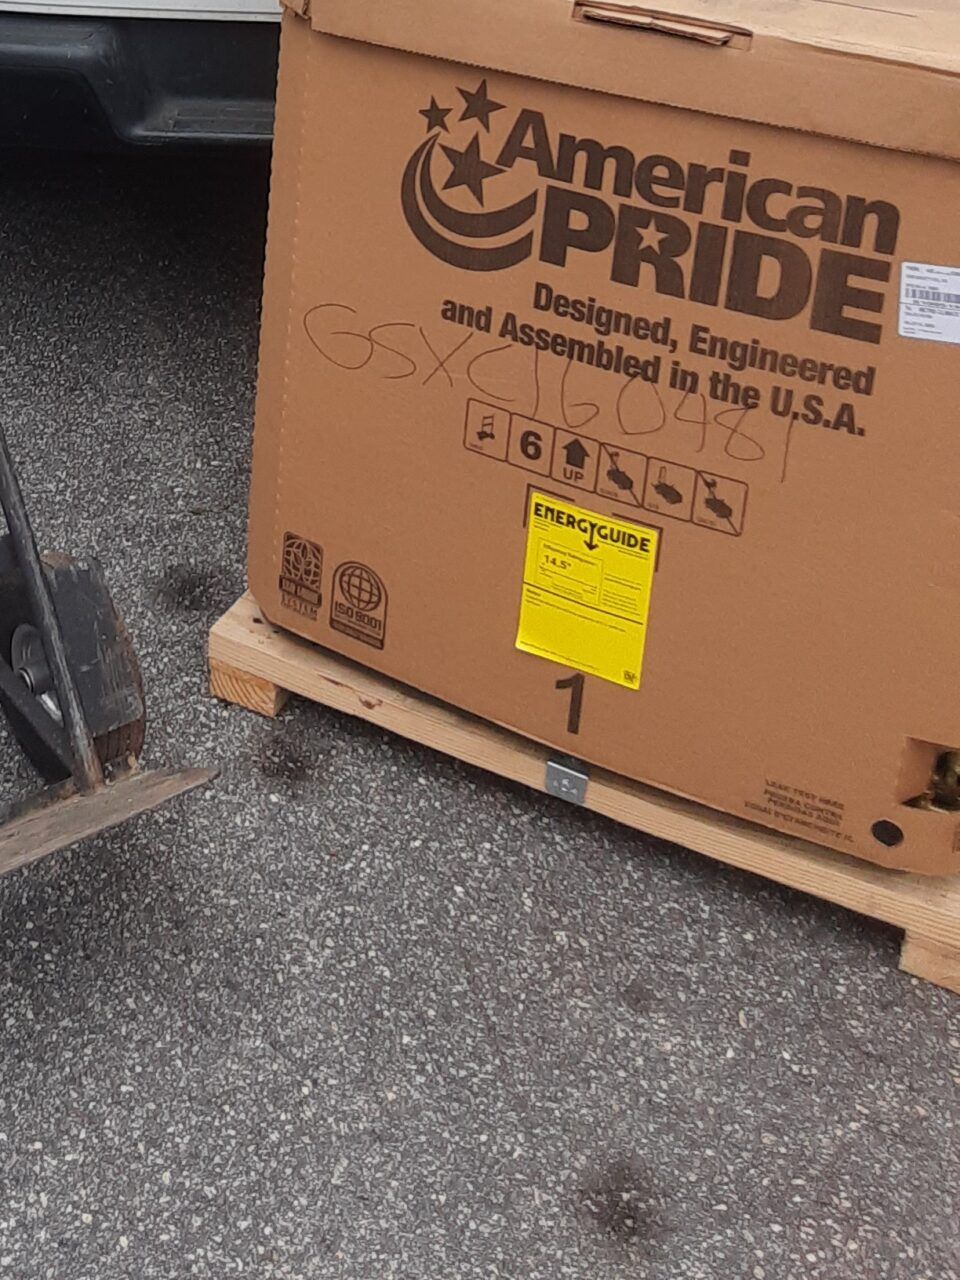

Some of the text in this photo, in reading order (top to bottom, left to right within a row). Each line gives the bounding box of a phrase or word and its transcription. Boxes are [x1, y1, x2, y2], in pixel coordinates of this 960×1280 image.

[497, 106, 900, 256] American
[539, 185, 892, 346] PRIDE
[440, 297, 868, 438] and Assembled in the U.S.A.
[533, 281, 877, 397] Designed, Engineered
[519, 429, 543, 461] 6
[562, 468, 584, 483] UP
[533, 501, 652, 553] ENERGYGUIDE
[334, 600, 354, 619] ISO
[355, 610, 382, 631] 9001
[554, 672, 585, 735] 1
